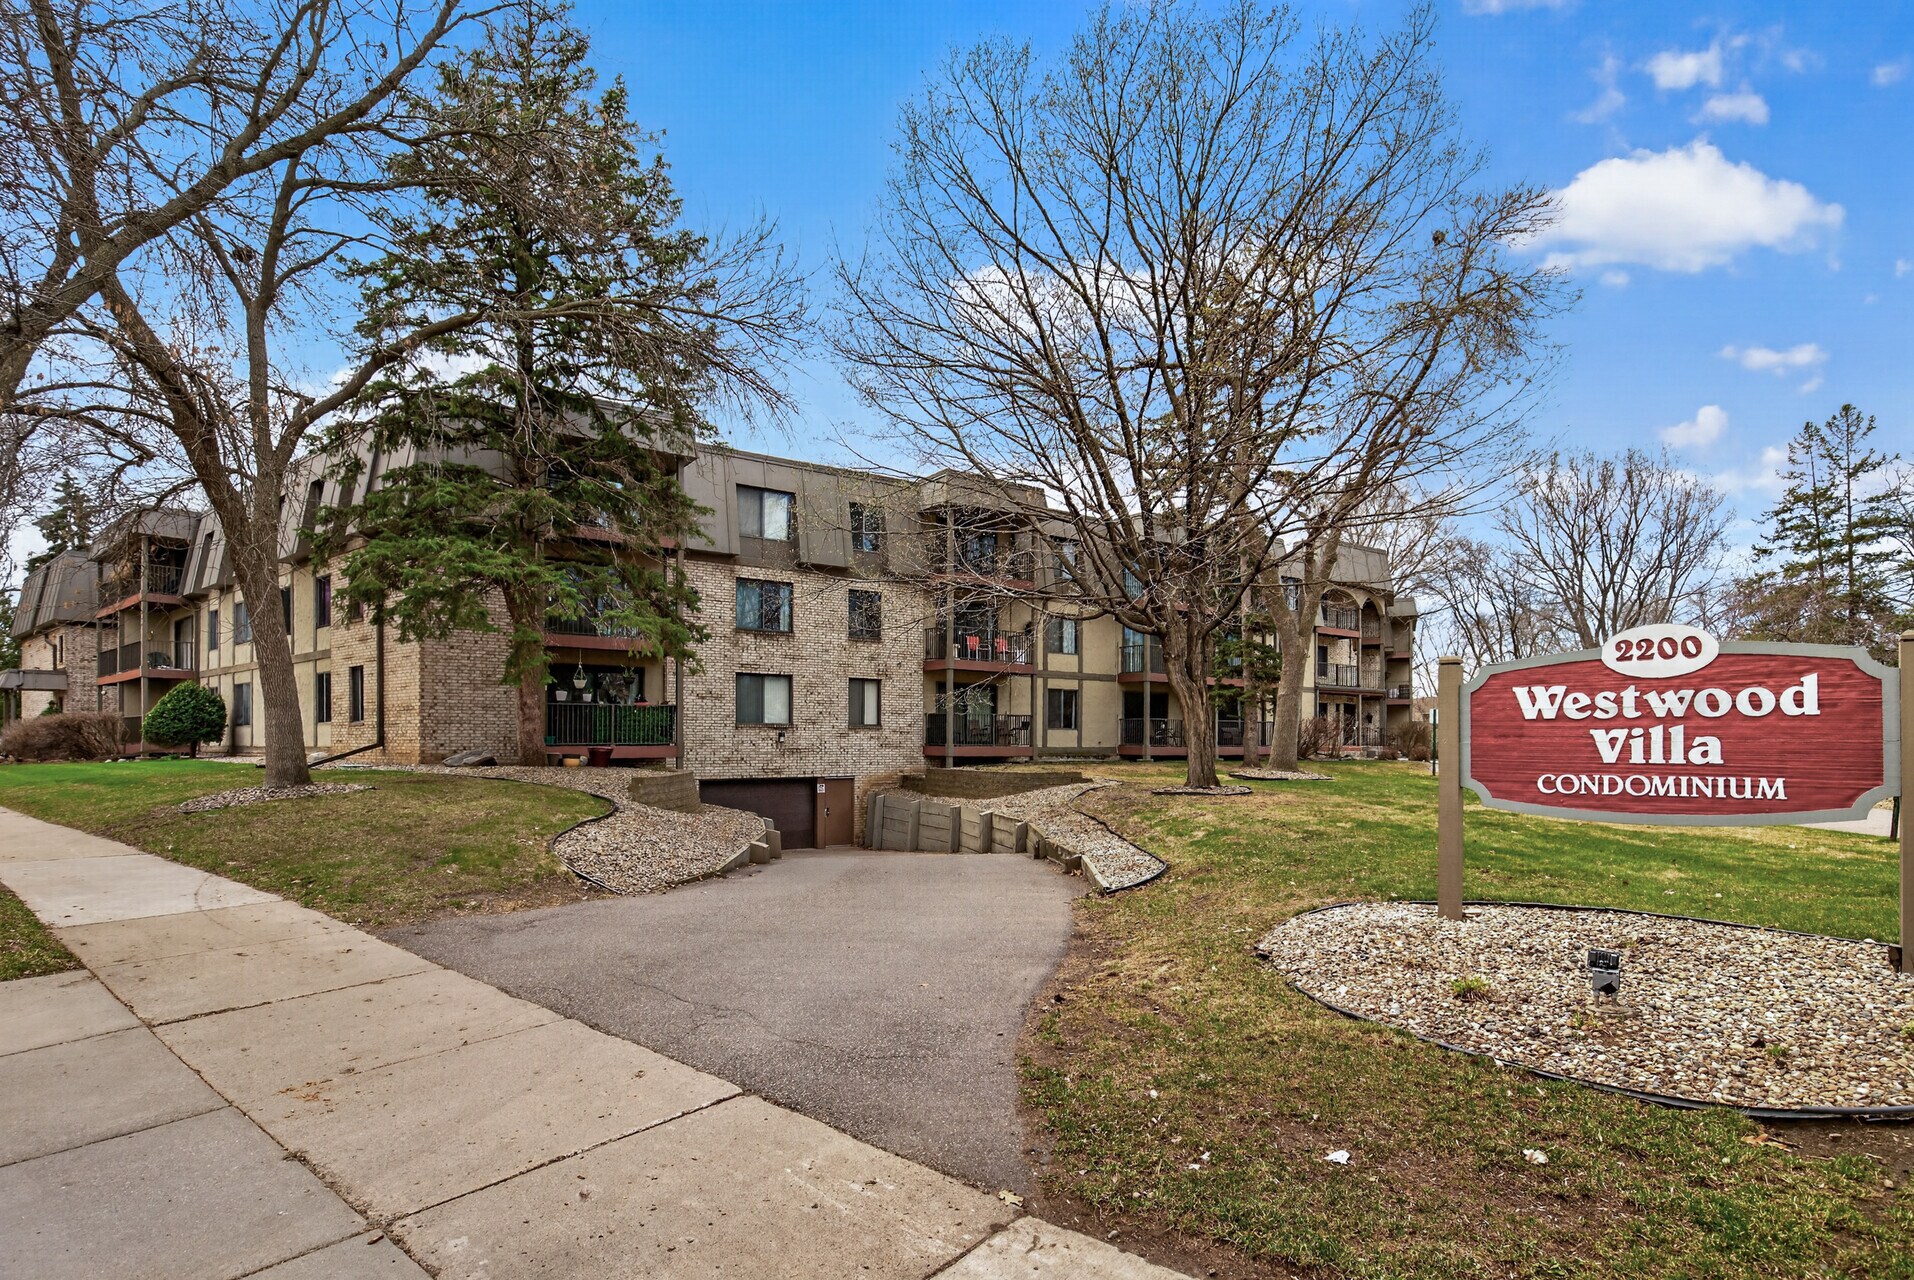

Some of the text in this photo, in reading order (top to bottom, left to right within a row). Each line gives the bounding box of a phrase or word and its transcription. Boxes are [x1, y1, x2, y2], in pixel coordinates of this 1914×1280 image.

[1615, 636, 1702, 662] 2200
[1513, 673, 1820, 719] Westwood
[1590, 725, 1723, 764] Villa
[1537, 774, 1787, 800] CONDOMINIUM
